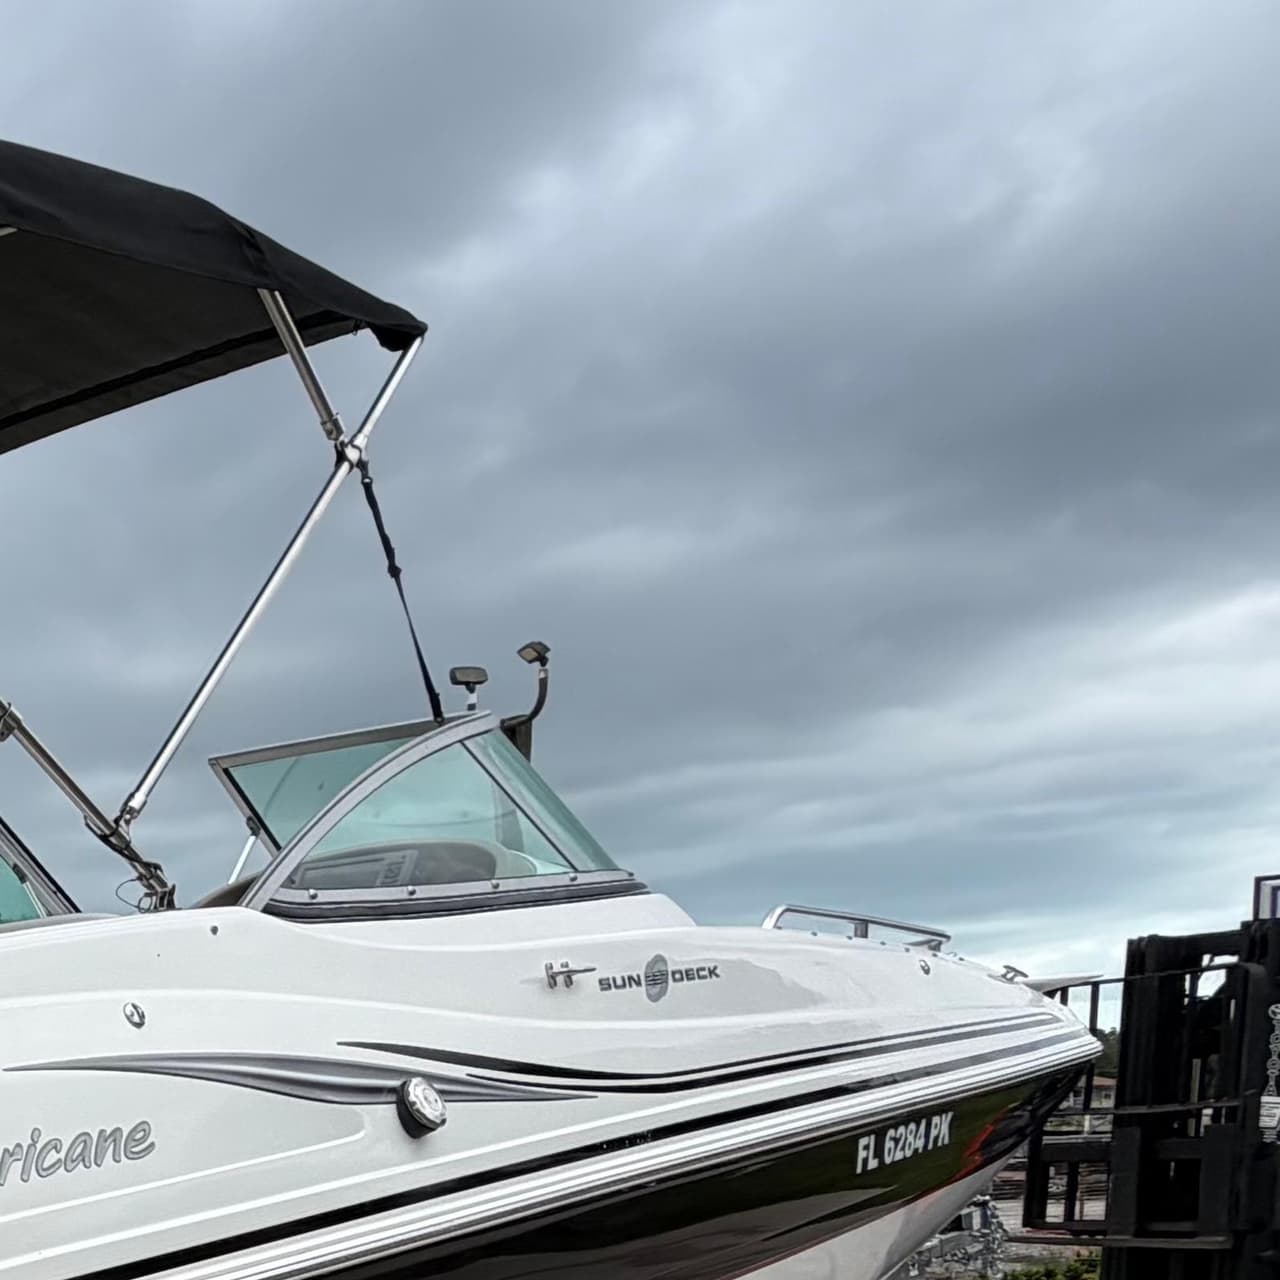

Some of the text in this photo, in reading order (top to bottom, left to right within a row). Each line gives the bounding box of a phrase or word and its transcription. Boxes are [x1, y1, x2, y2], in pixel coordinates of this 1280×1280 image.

[598, 965, 720, 992] SUN DECK
[856, 1134, 879, 1174] FL
[884, 1118, 927, 1165] 6284
